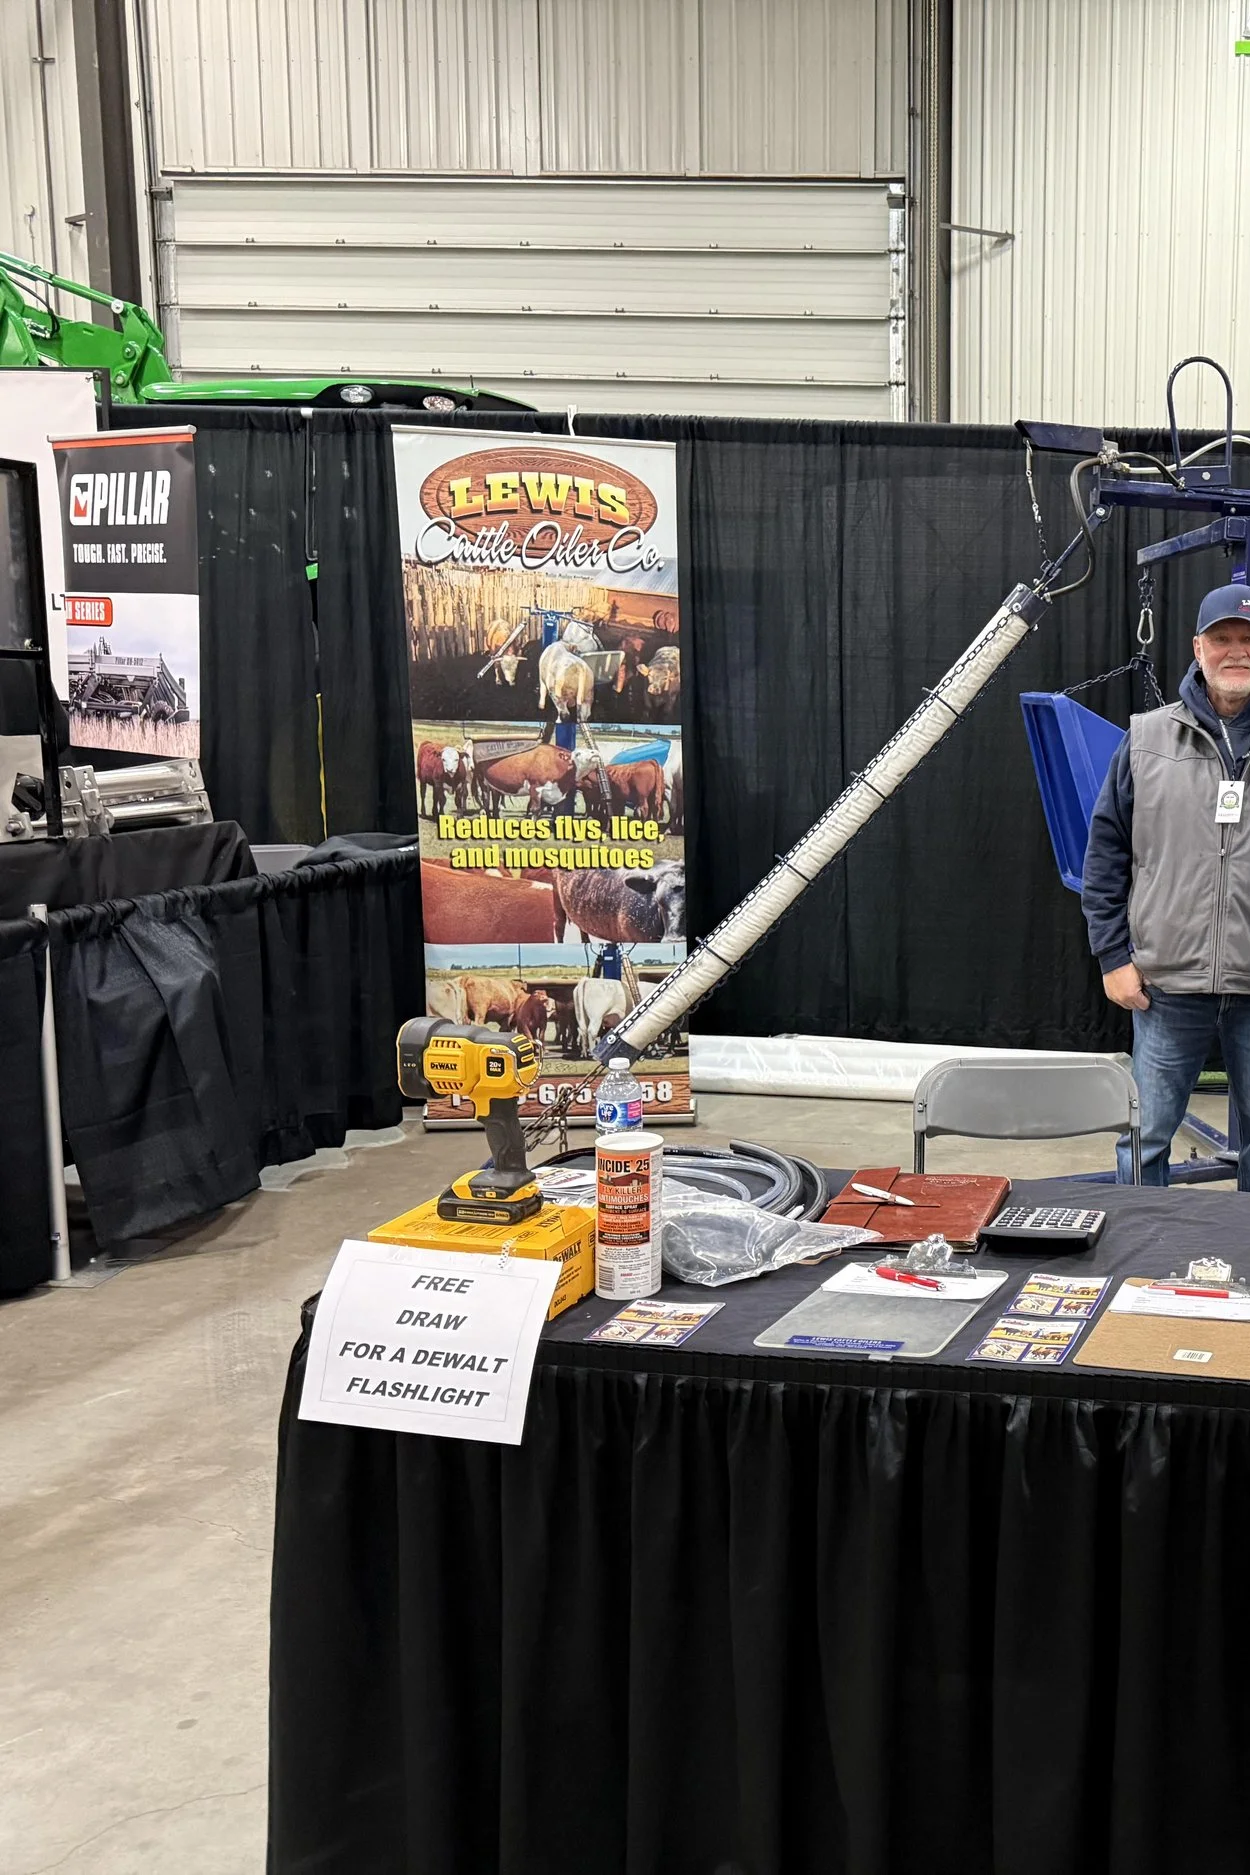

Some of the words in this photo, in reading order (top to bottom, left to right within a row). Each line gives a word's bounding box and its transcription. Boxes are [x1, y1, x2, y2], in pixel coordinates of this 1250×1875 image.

[92, 470, 171, 526] PILLAR
[449, 471, 630, 526] LEWIS
[73, 543, 106, 563] TOUGH.
[107, 543, 129, 564] FAST.
[131, 543, 167, 564] PRECISE.
[416, 517, 517, 565] Cattle
[520, 520, 607, 570] Oiler
[606, 525, 665, 574] Co.
[75, 601, 105, 621] SERIES
[439, 814, 550, 840] Reduces
[554, 815, 607, 842] flys,
[611, 815, 665, 842] lice,
[451, 844, 500, 868] and
[505, 844, 655, 871] mosquitoes
[636, 1158, 650, 1172] 25
[615, 1185, 642, 1195] KILLER
[411, 1275, 474, 1294] FREE
[396, 1309, 468, 1331] DRAW
[338, 1341, 387, 1361] FOR
[389, 1347, 406, 1363] A
[411, 1349, 509, 1374] DEWALT
[346, 1376, 491, 1407] FLASHLIGHT
